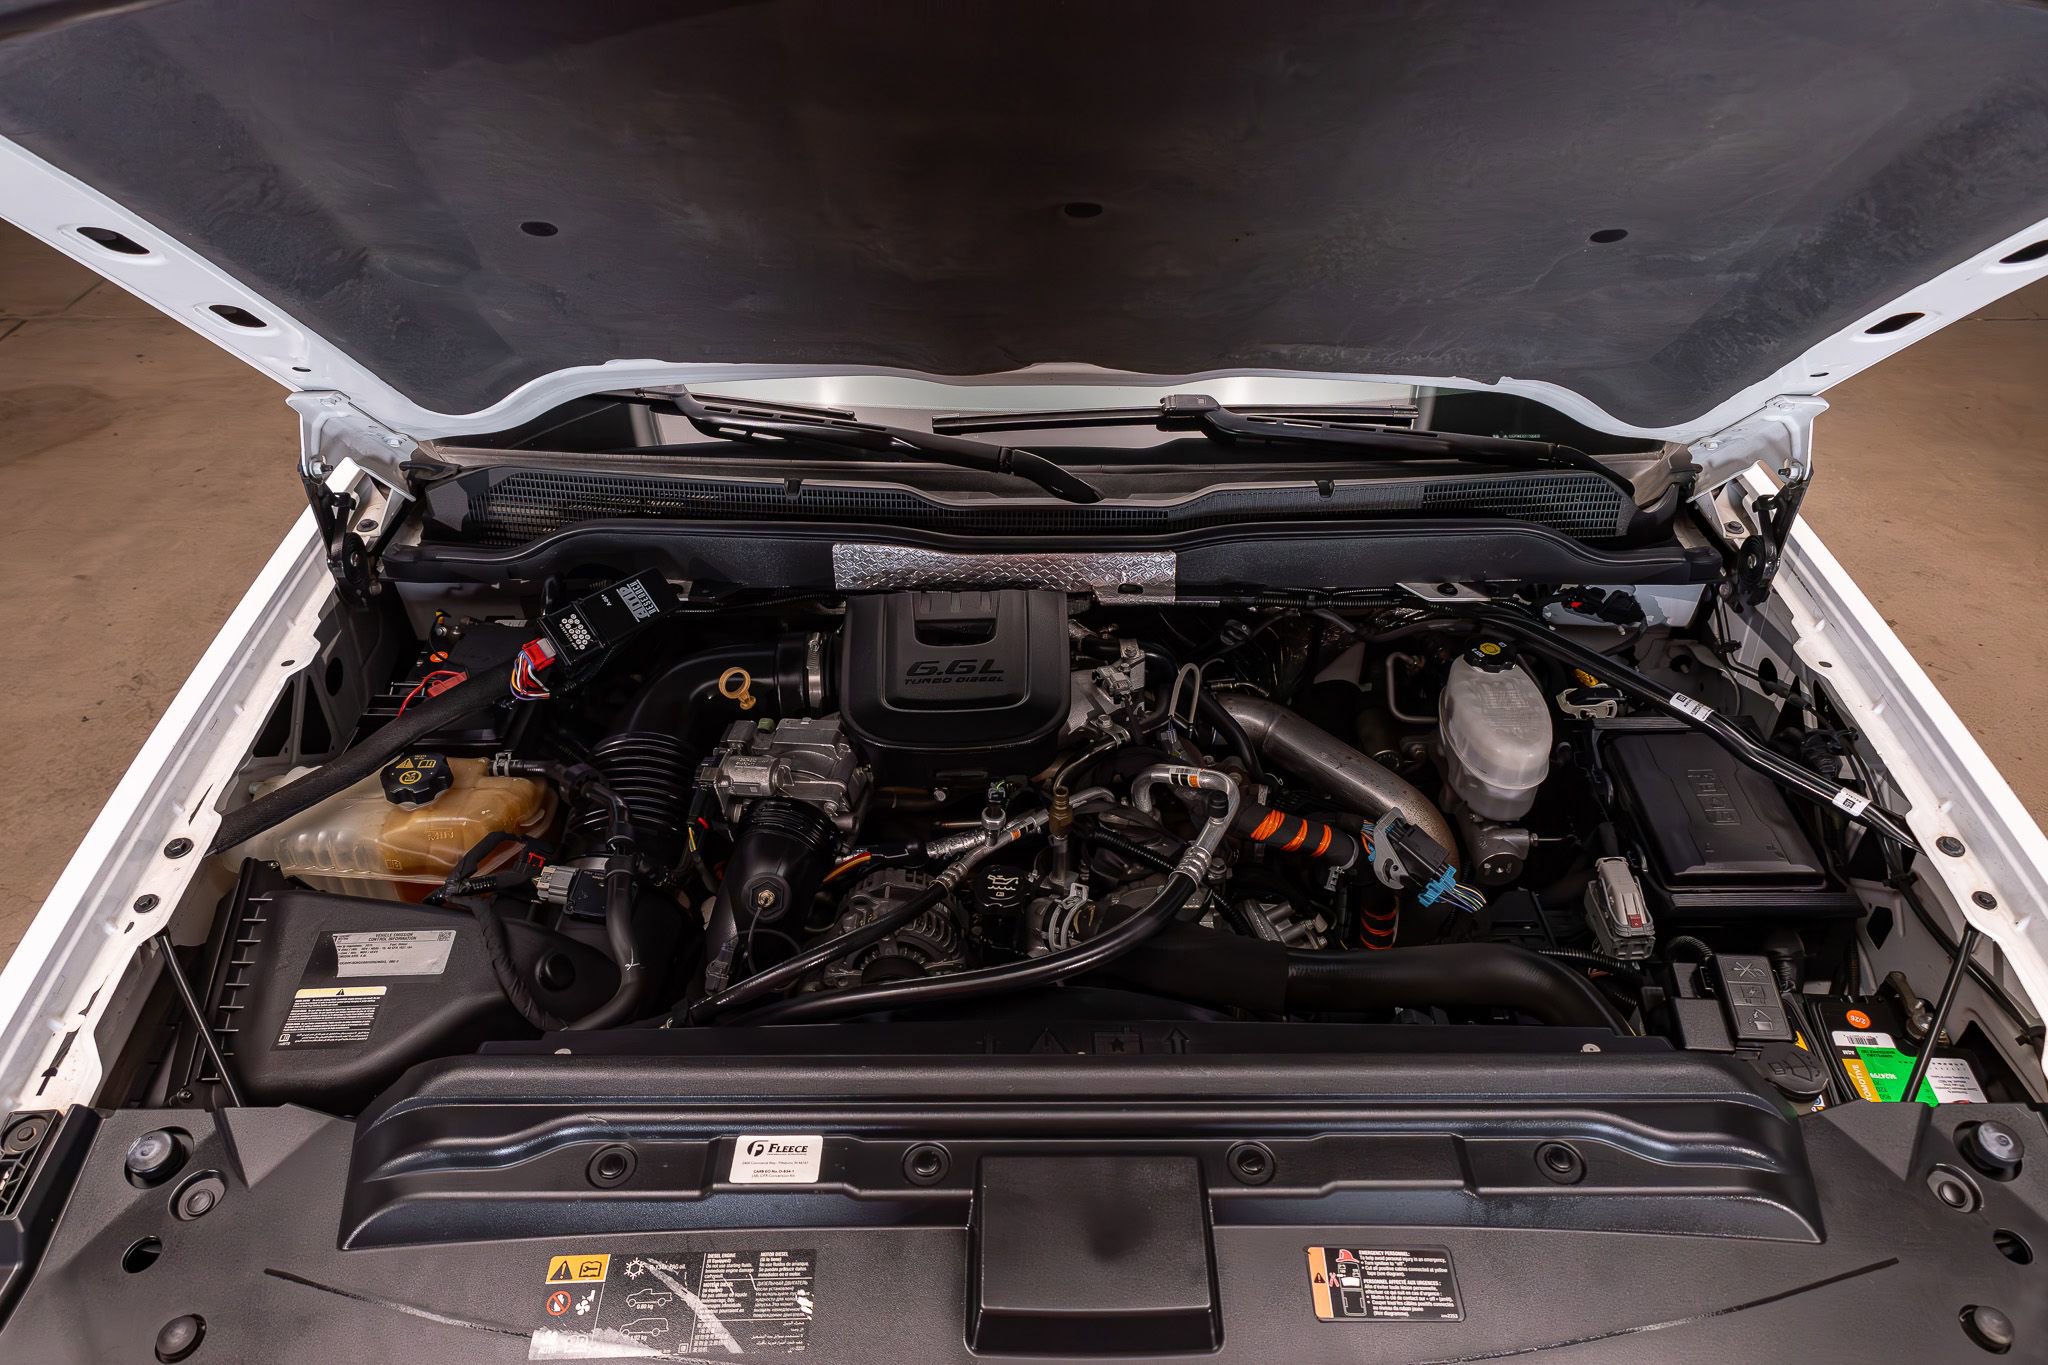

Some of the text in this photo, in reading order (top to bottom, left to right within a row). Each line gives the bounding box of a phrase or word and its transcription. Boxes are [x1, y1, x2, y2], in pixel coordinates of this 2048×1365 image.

[629, 580, 657, 615] RESEARCH
[906, 659, 1004, 676] 6.6L
[905, 677, 952, 685] TURBO
[768, 1143, 808, 1153] FLEECE
